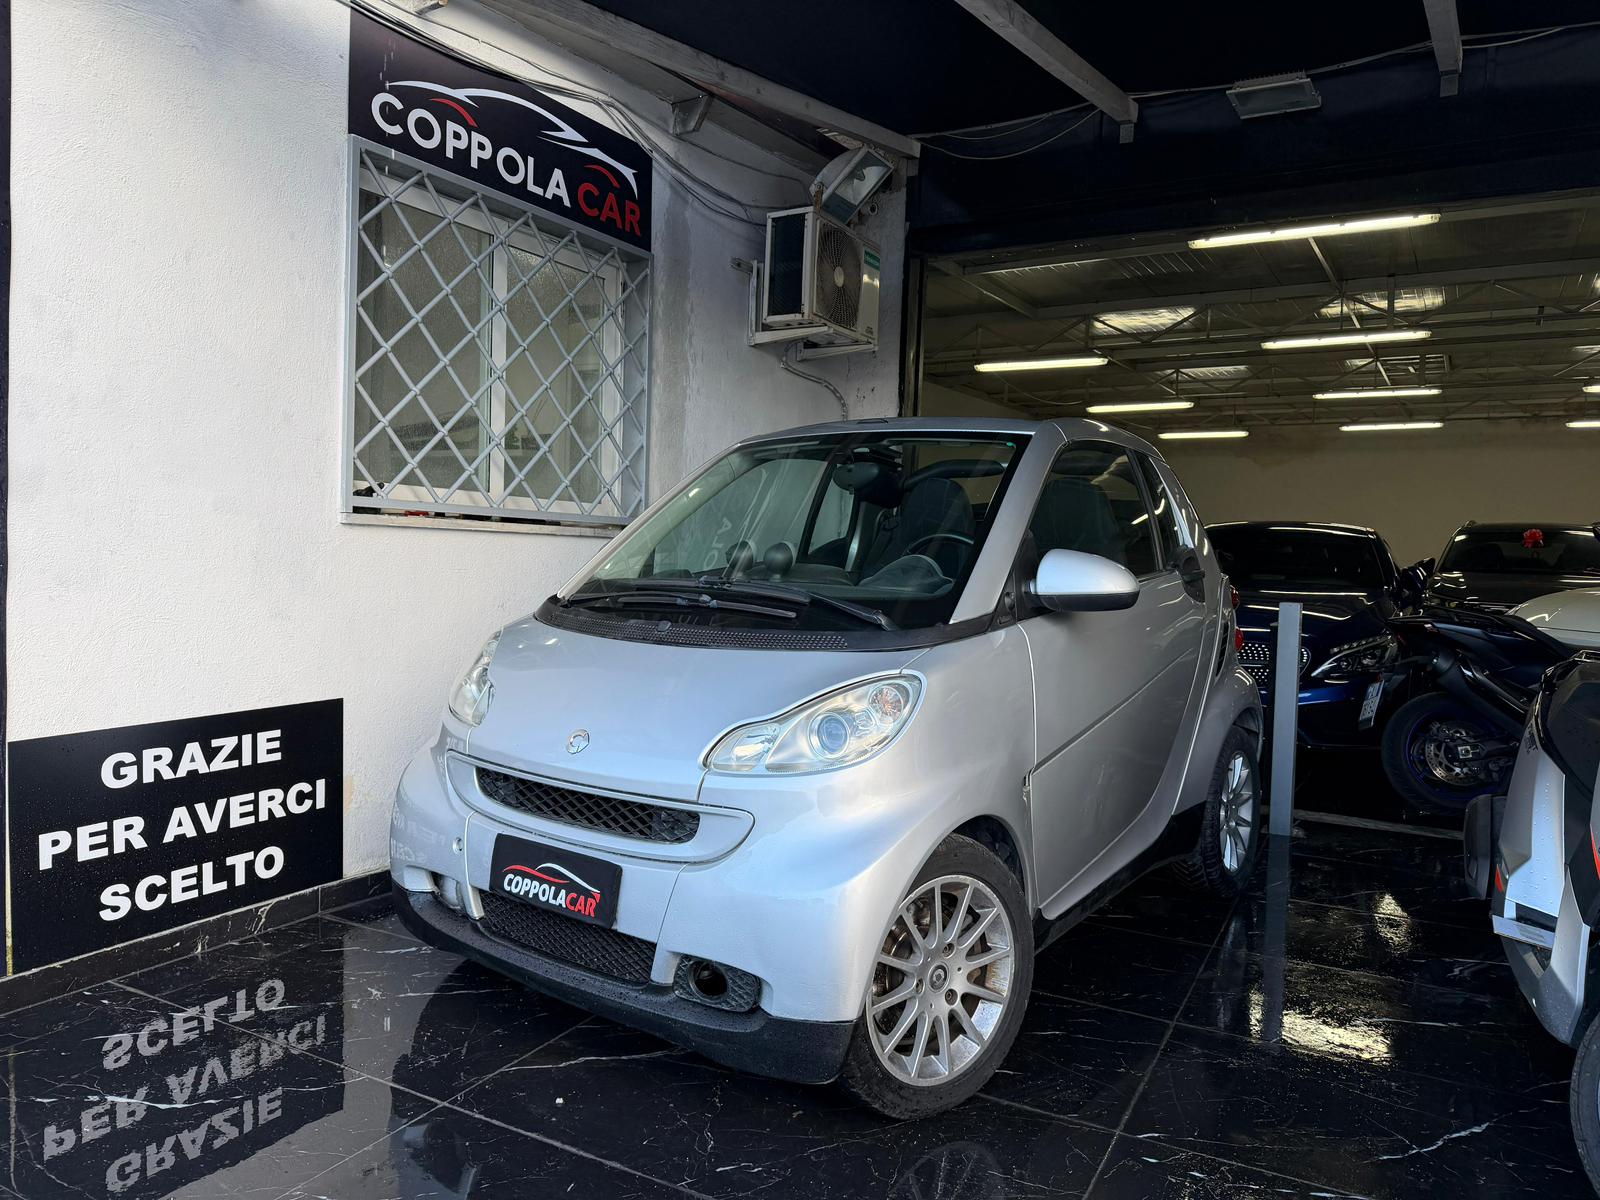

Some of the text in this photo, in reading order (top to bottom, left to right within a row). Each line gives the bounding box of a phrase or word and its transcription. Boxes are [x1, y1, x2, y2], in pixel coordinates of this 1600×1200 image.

[371, 92, 641, 237] COPPOLA CAR
[101, 729, 282, 789] GRAZIE
[38, 778, 326, 871] PER AVERCI
[99, 846, 284, 921] SCELTO
